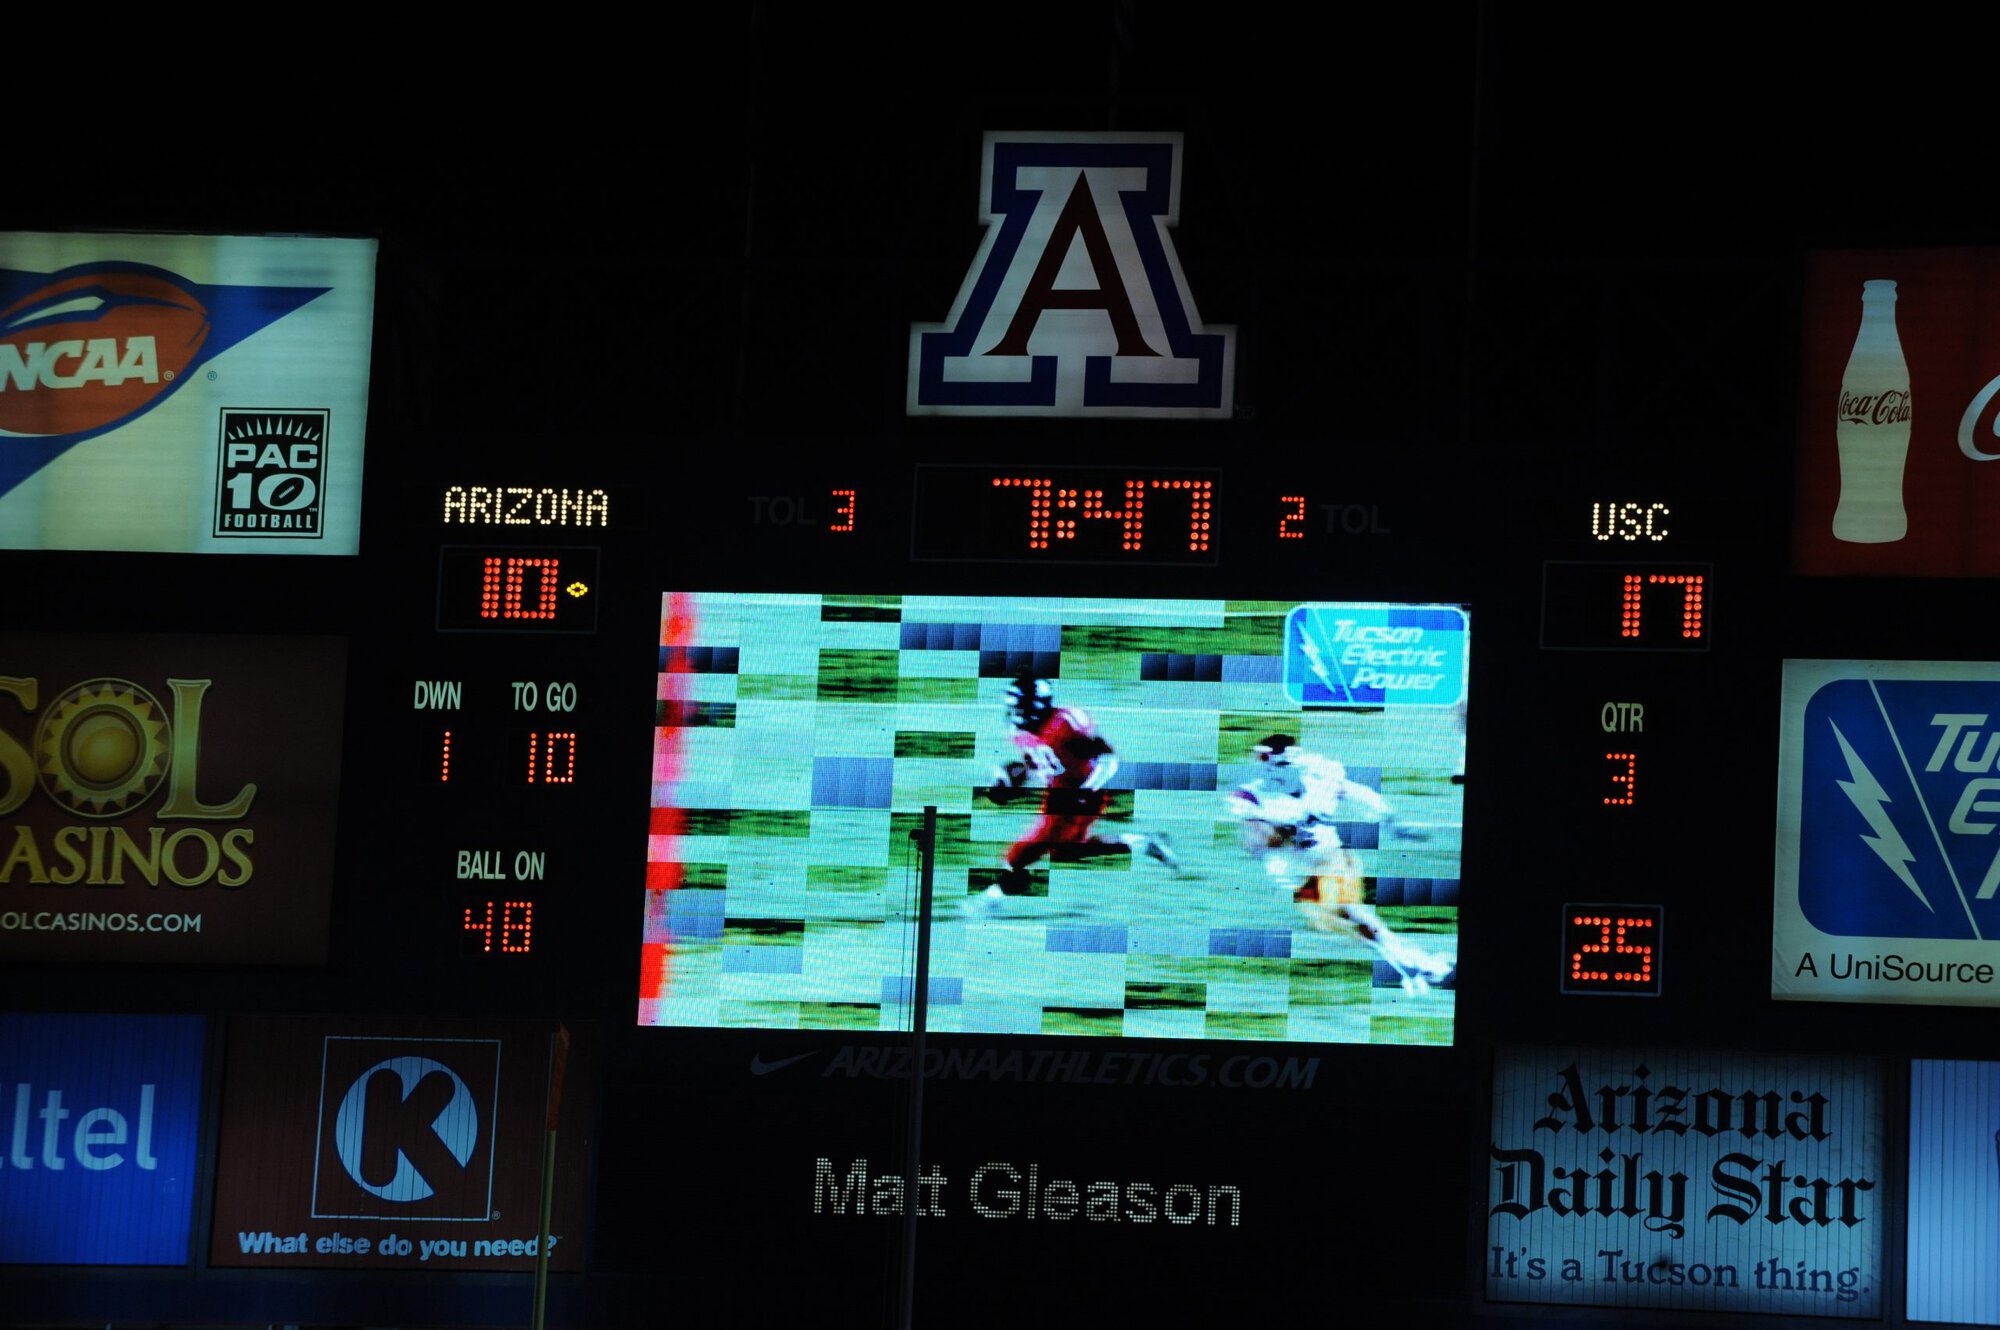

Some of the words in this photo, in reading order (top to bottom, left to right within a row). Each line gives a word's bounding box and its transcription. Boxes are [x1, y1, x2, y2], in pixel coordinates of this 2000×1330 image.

[0, 335, 160, 393] NCAA
[1839, 390, 1911, 425] Coca-Cola
[226, 442, 318, 470] PAC
[226, 472, 317, 511] 10
[443, 485, 609, 527] ARIZONA
[747, 496, 816, 527] TOL
[829, 489, 857, 533] 3
[223, 513, 313, 529] FOOTBALL
[992, 477, 1213, 552] 7:47
[1278, 495, 1306, 539] 2
[1323, 504, 1391, 535] TOL
[1591, 502, 1670, 541] USC
[480, 556, 560, 621] 10
[1621, 573, 1704, 639] 17
[1333, 620, 1424, 643] Tucson
[413, 680, 463, 711] DWN
[511, 682, 539, 712] TO
[545, 682, 578, 713] GO
[1350, 667, 1445, 690] Power
[1600, 702, 1645, 734] QTR
[527, 731, 577, 785] 10
[1602, 752, 1637, 807] 3
[456, 850, 507, 880] BALL
[514, 851, 546, 881] ON
[463, 901, 534, 954] 48
[1570, 916, 1654, 983] 25
[1795, 952, 1818, 978] A
[1830, 953, 1994, 984] UniSource
[1533, 1062, 1832, 1142] Arizona
[0, 1082, 159, 1171] ltel
[968, 1162, 1242, 1227] Gleason
[1488, 1142, 1692, 1240] Daily
[1706, 1152, 1876, 1228] Star
[238, 1231, 309, 1255] What
[315, 1232, 372, 1256] else
[377, 1233, 413, 1257] do
[418, 1237, 467, 1262] you
[1491, 1245, 1546, 1281] It's
[1560, 1258, 1583, 1281] a
[1598, 1249, 1740, 1288] Tucson
[1753, 1256, 1871, 1302] thing.
